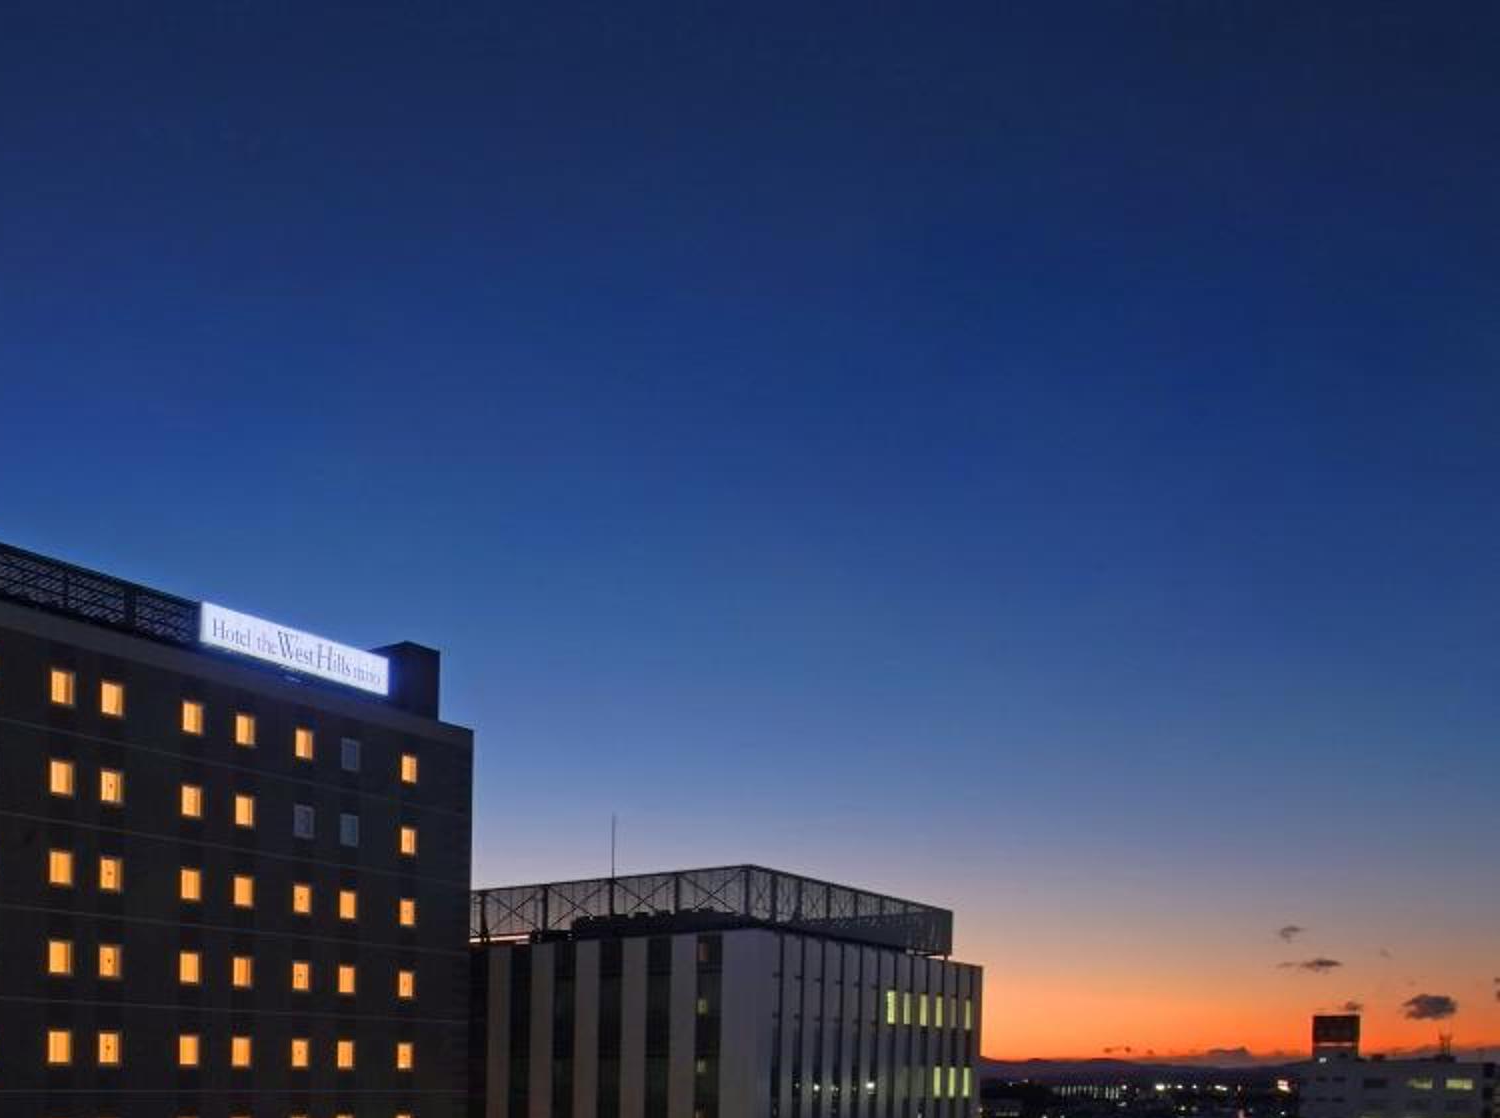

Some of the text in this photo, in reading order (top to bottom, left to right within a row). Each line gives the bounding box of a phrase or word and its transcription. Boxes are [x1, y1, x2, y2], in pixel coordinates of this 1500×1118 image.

[212, 618, 251, 648] Hotel
[256, 631, 278, 655] the
[277, 630, 314, 664] West
[316, 643, 352, 676] Hills
